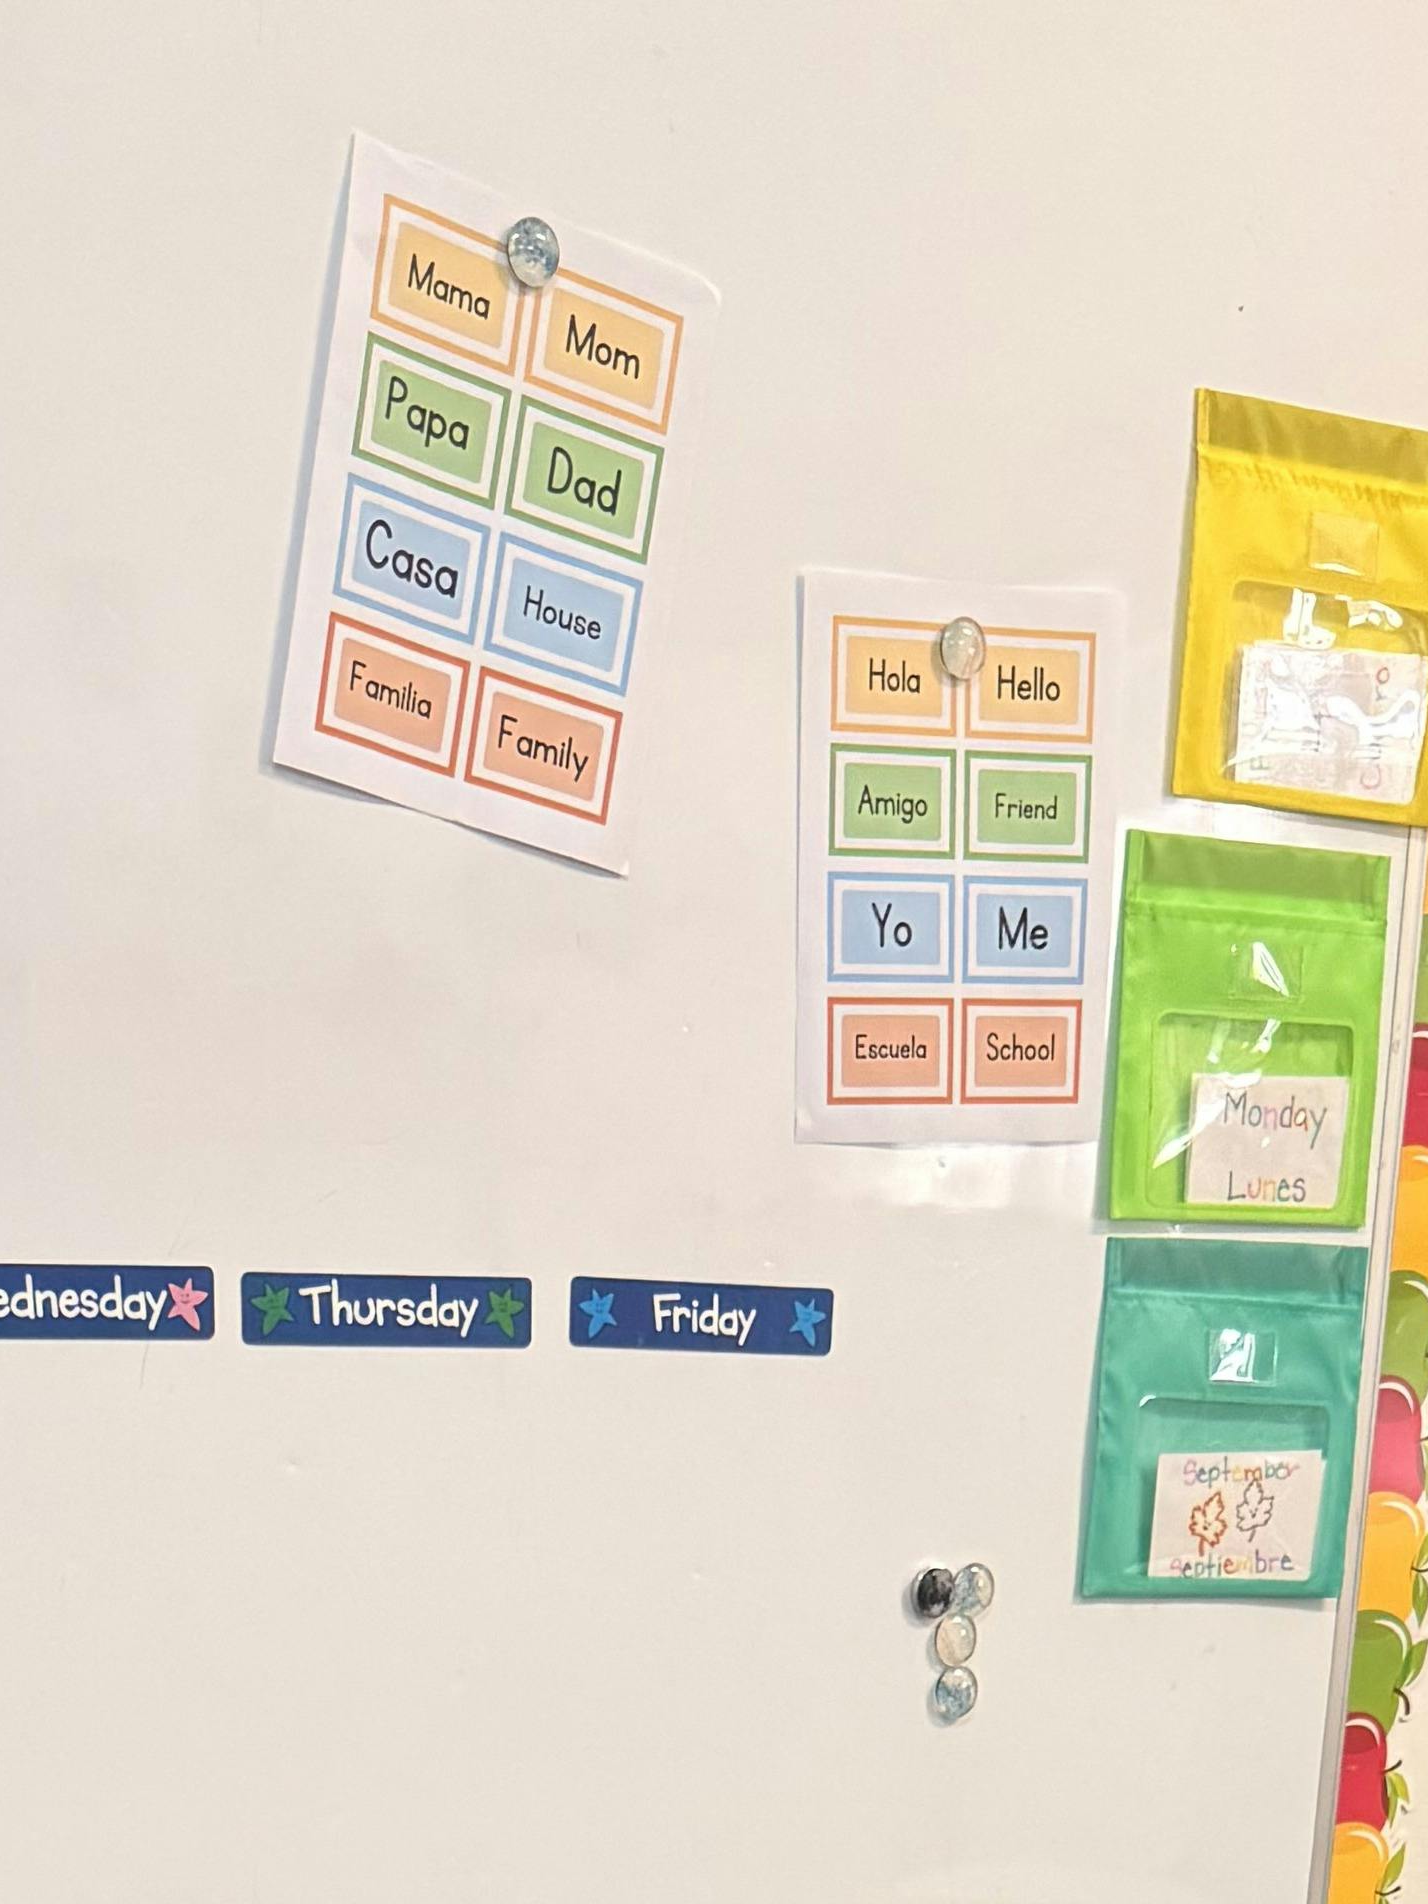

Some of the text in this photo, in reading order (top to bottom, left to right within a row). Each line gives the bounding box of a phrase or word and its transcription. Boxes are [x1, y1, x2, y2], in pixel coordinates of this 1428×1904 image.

[408, 254, 489, 318] Mama
[567, 315, 639, 379] Mom
[386, 376, 469, 449] Papa
[548, 447, 621, 515] Dad
[367, 520, 458, 598] Casa
[524, 586, 600, 639] House
[351, 661, 431, 718] Familia
[870, 658, 920, 693] Hola
[998, 666, 1060, 701] Hello
[499, 715, 588, 781] Family
[859, 785, 927, 823] Amigo
[996, 793, 1057, 819] Friend
[872, 903, 912, 947] Yo
[999, 907, 1048, 949] Me
[856, 1035, 926, 1059] Escuela
[987, 1033, 1054, 1061] School
[1223, 1092, 1327, 1149] Monday
[1228, 1171, 1306, 1203] Lunes
[299, 1279, 478, 1337] Thursday
[654, 1293, 756, 1345] Friday
[1183, 1456, 1300, 1488] September
[1170, 1549, 1294, 1579] Septiembre
